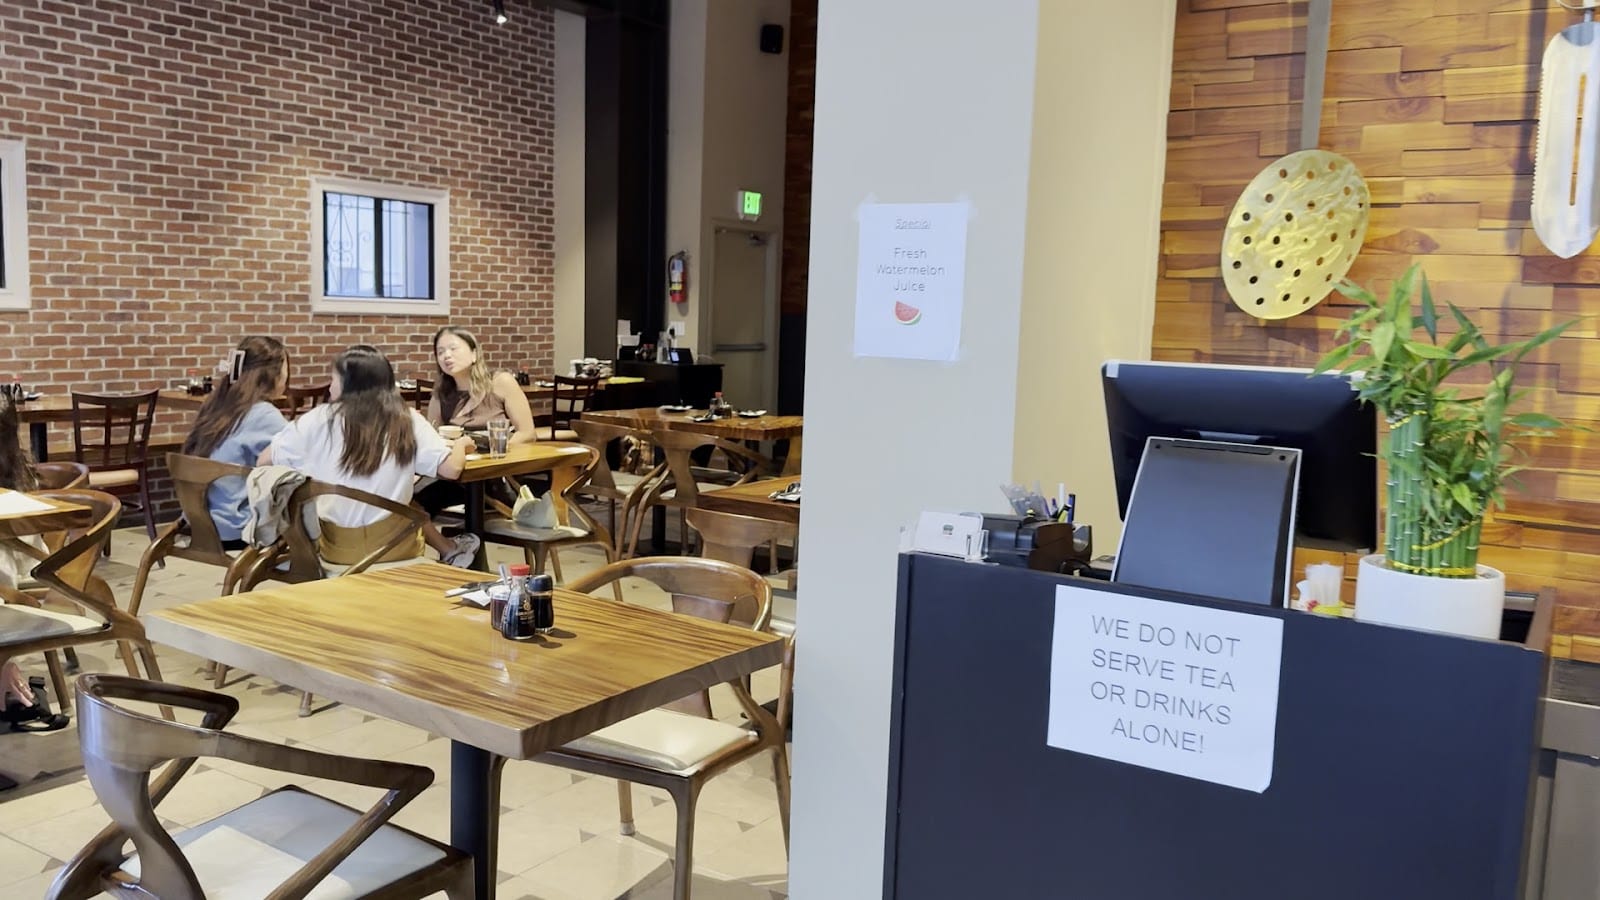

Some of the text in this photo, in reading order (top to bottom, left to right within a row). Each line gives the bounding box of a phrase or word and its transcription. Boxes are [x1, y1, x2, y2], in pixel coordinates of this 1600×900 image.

[876, 264, 945, 276] Watermelon
[893, 247, 928, 259] Fresh
[893, 280, 926, 292] Juice
[1091, 615, 1241, 657] WE DO NOT
[1091, 648, 1236, 692] SERVE TEA
[1090, 681, 1231, 725] OR DRINKS
[1111, 717, 1205, 754] ALONE!
